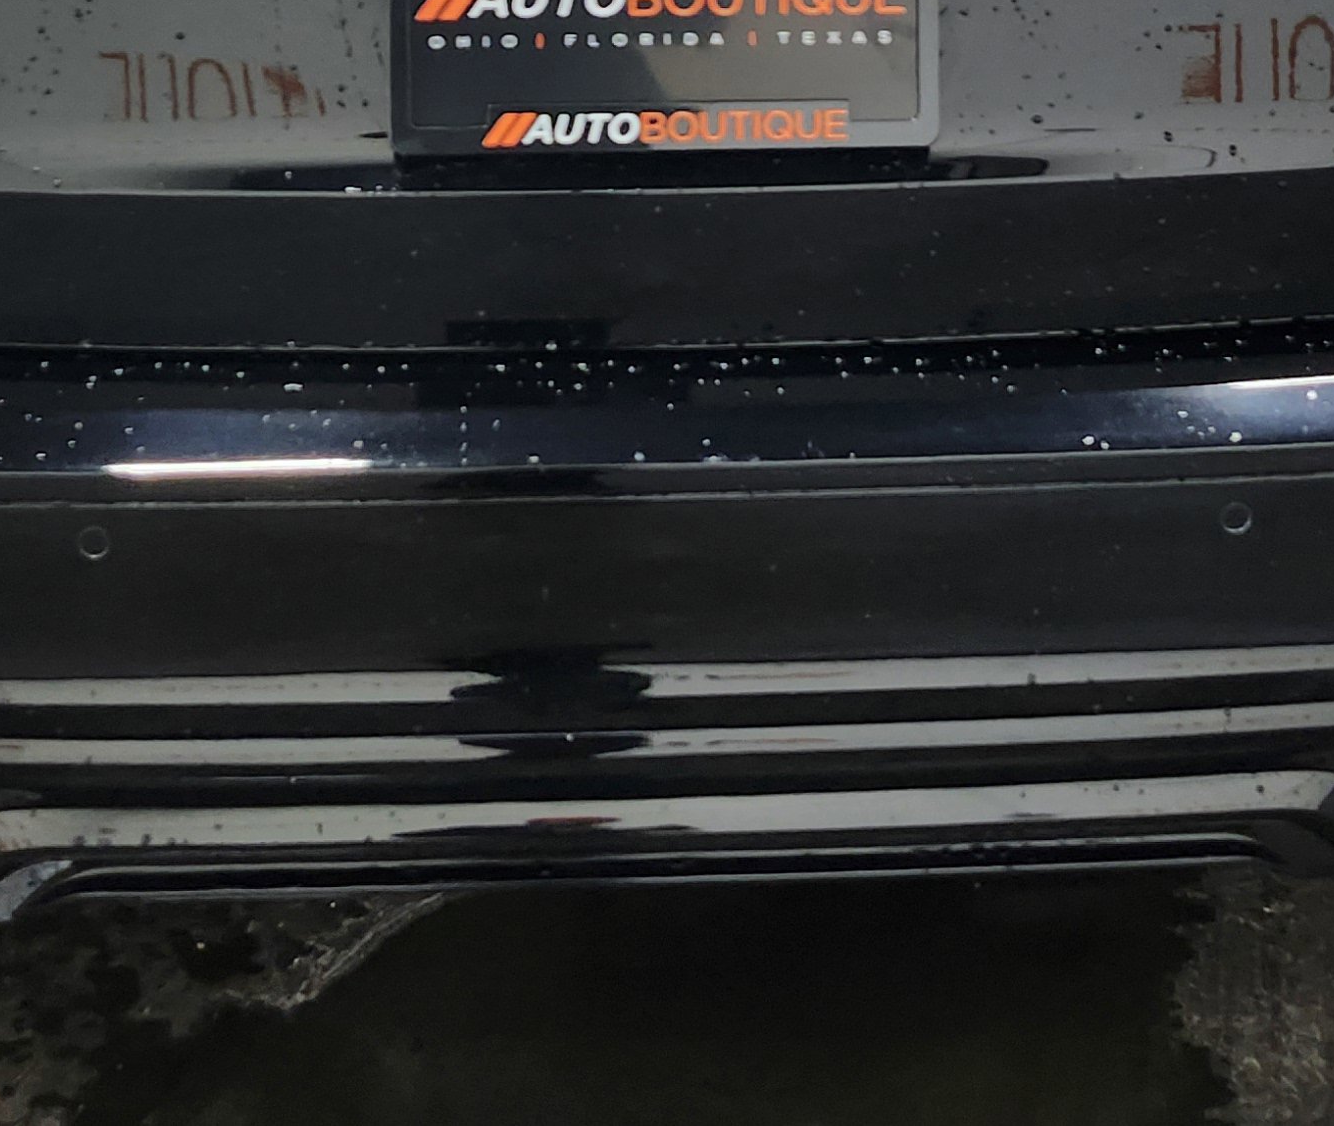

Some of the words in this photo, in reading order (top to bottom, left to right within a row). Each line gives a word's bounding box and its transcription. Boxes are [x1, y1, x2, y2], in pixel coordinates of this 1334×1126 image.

[426, 32, 519, 50] OHIO
[562, 31, 726, 49] FLORIDA
[776, 29, 893, 46] TEXAS
[521, 108, 850, 146] AUTOBOUTIQUE
